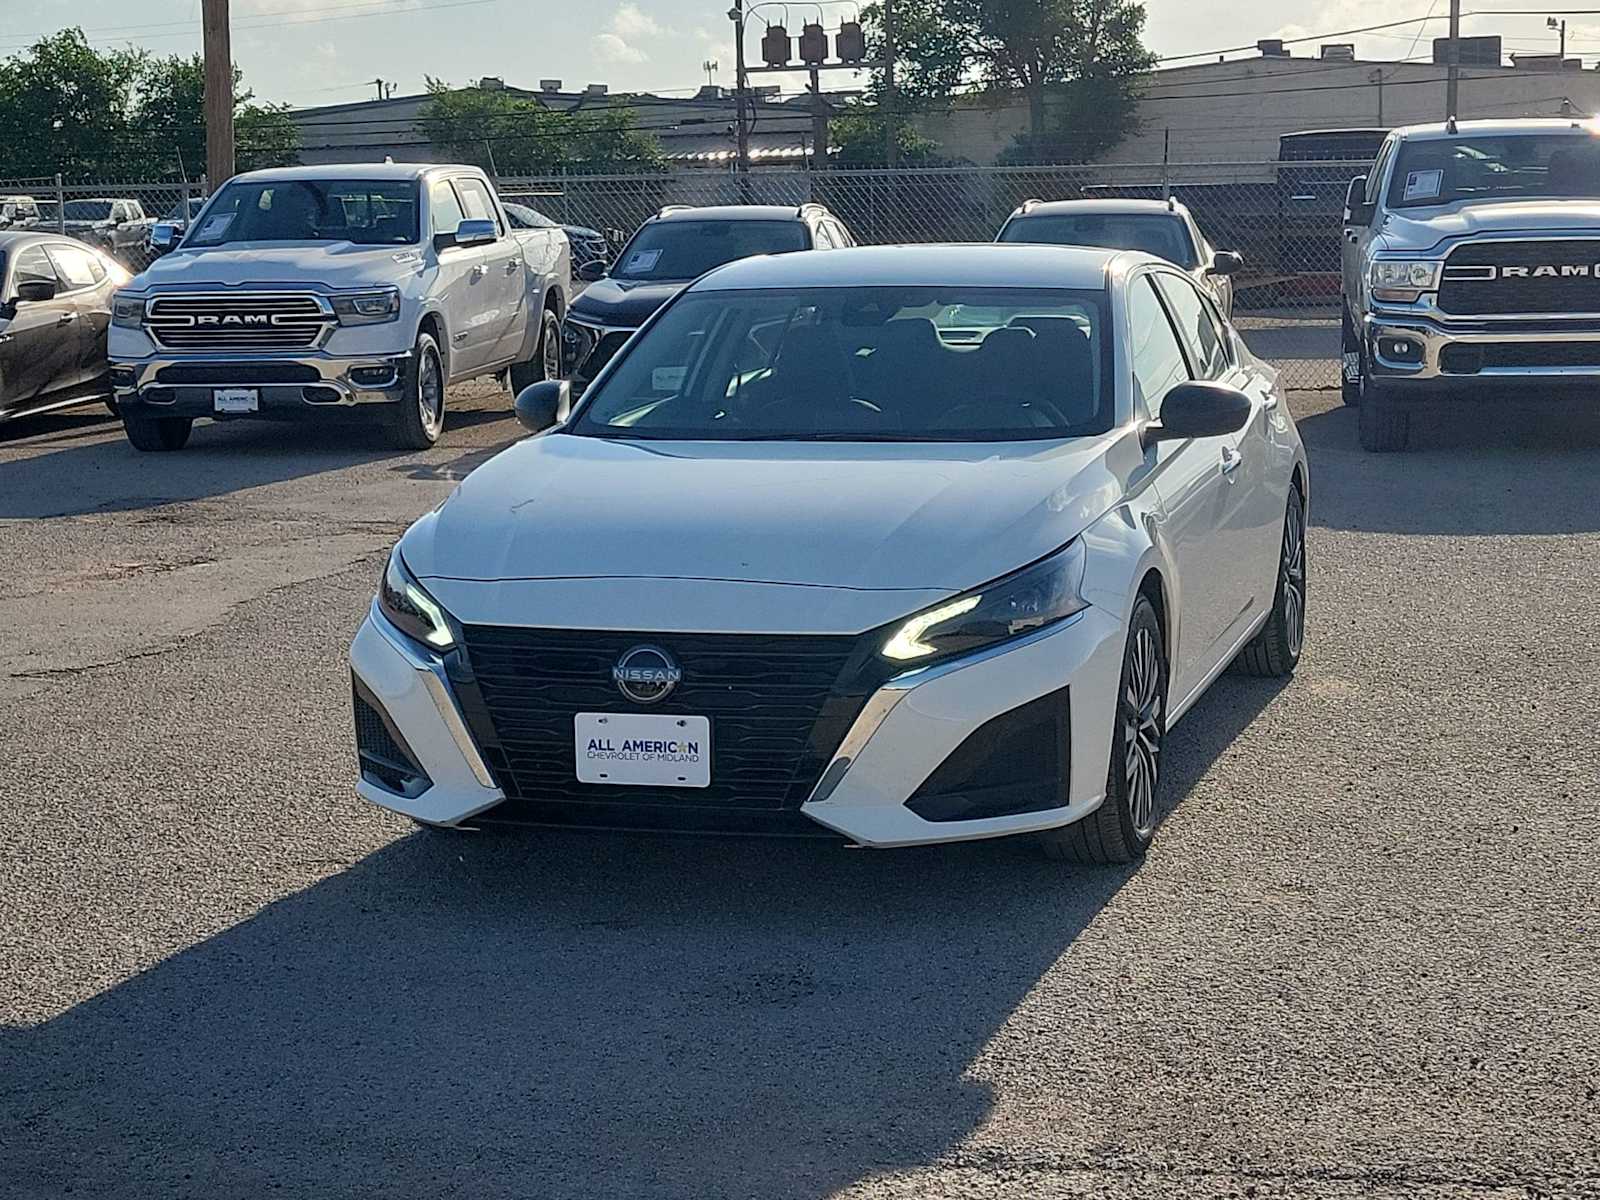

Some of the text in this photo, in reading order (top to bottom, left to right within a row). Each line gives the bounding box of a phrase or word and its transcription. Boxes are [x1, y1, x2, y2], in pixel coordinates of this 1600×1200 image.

[1502, 265, 1588, 277] RAM
[197, 314, 268, 325] RAM
[613, 667, 681, 681] NISSAN
[587, 739, 615, 751] ALL
[587, 751, 699, 763] CHEVROLET OF MIDLAND
